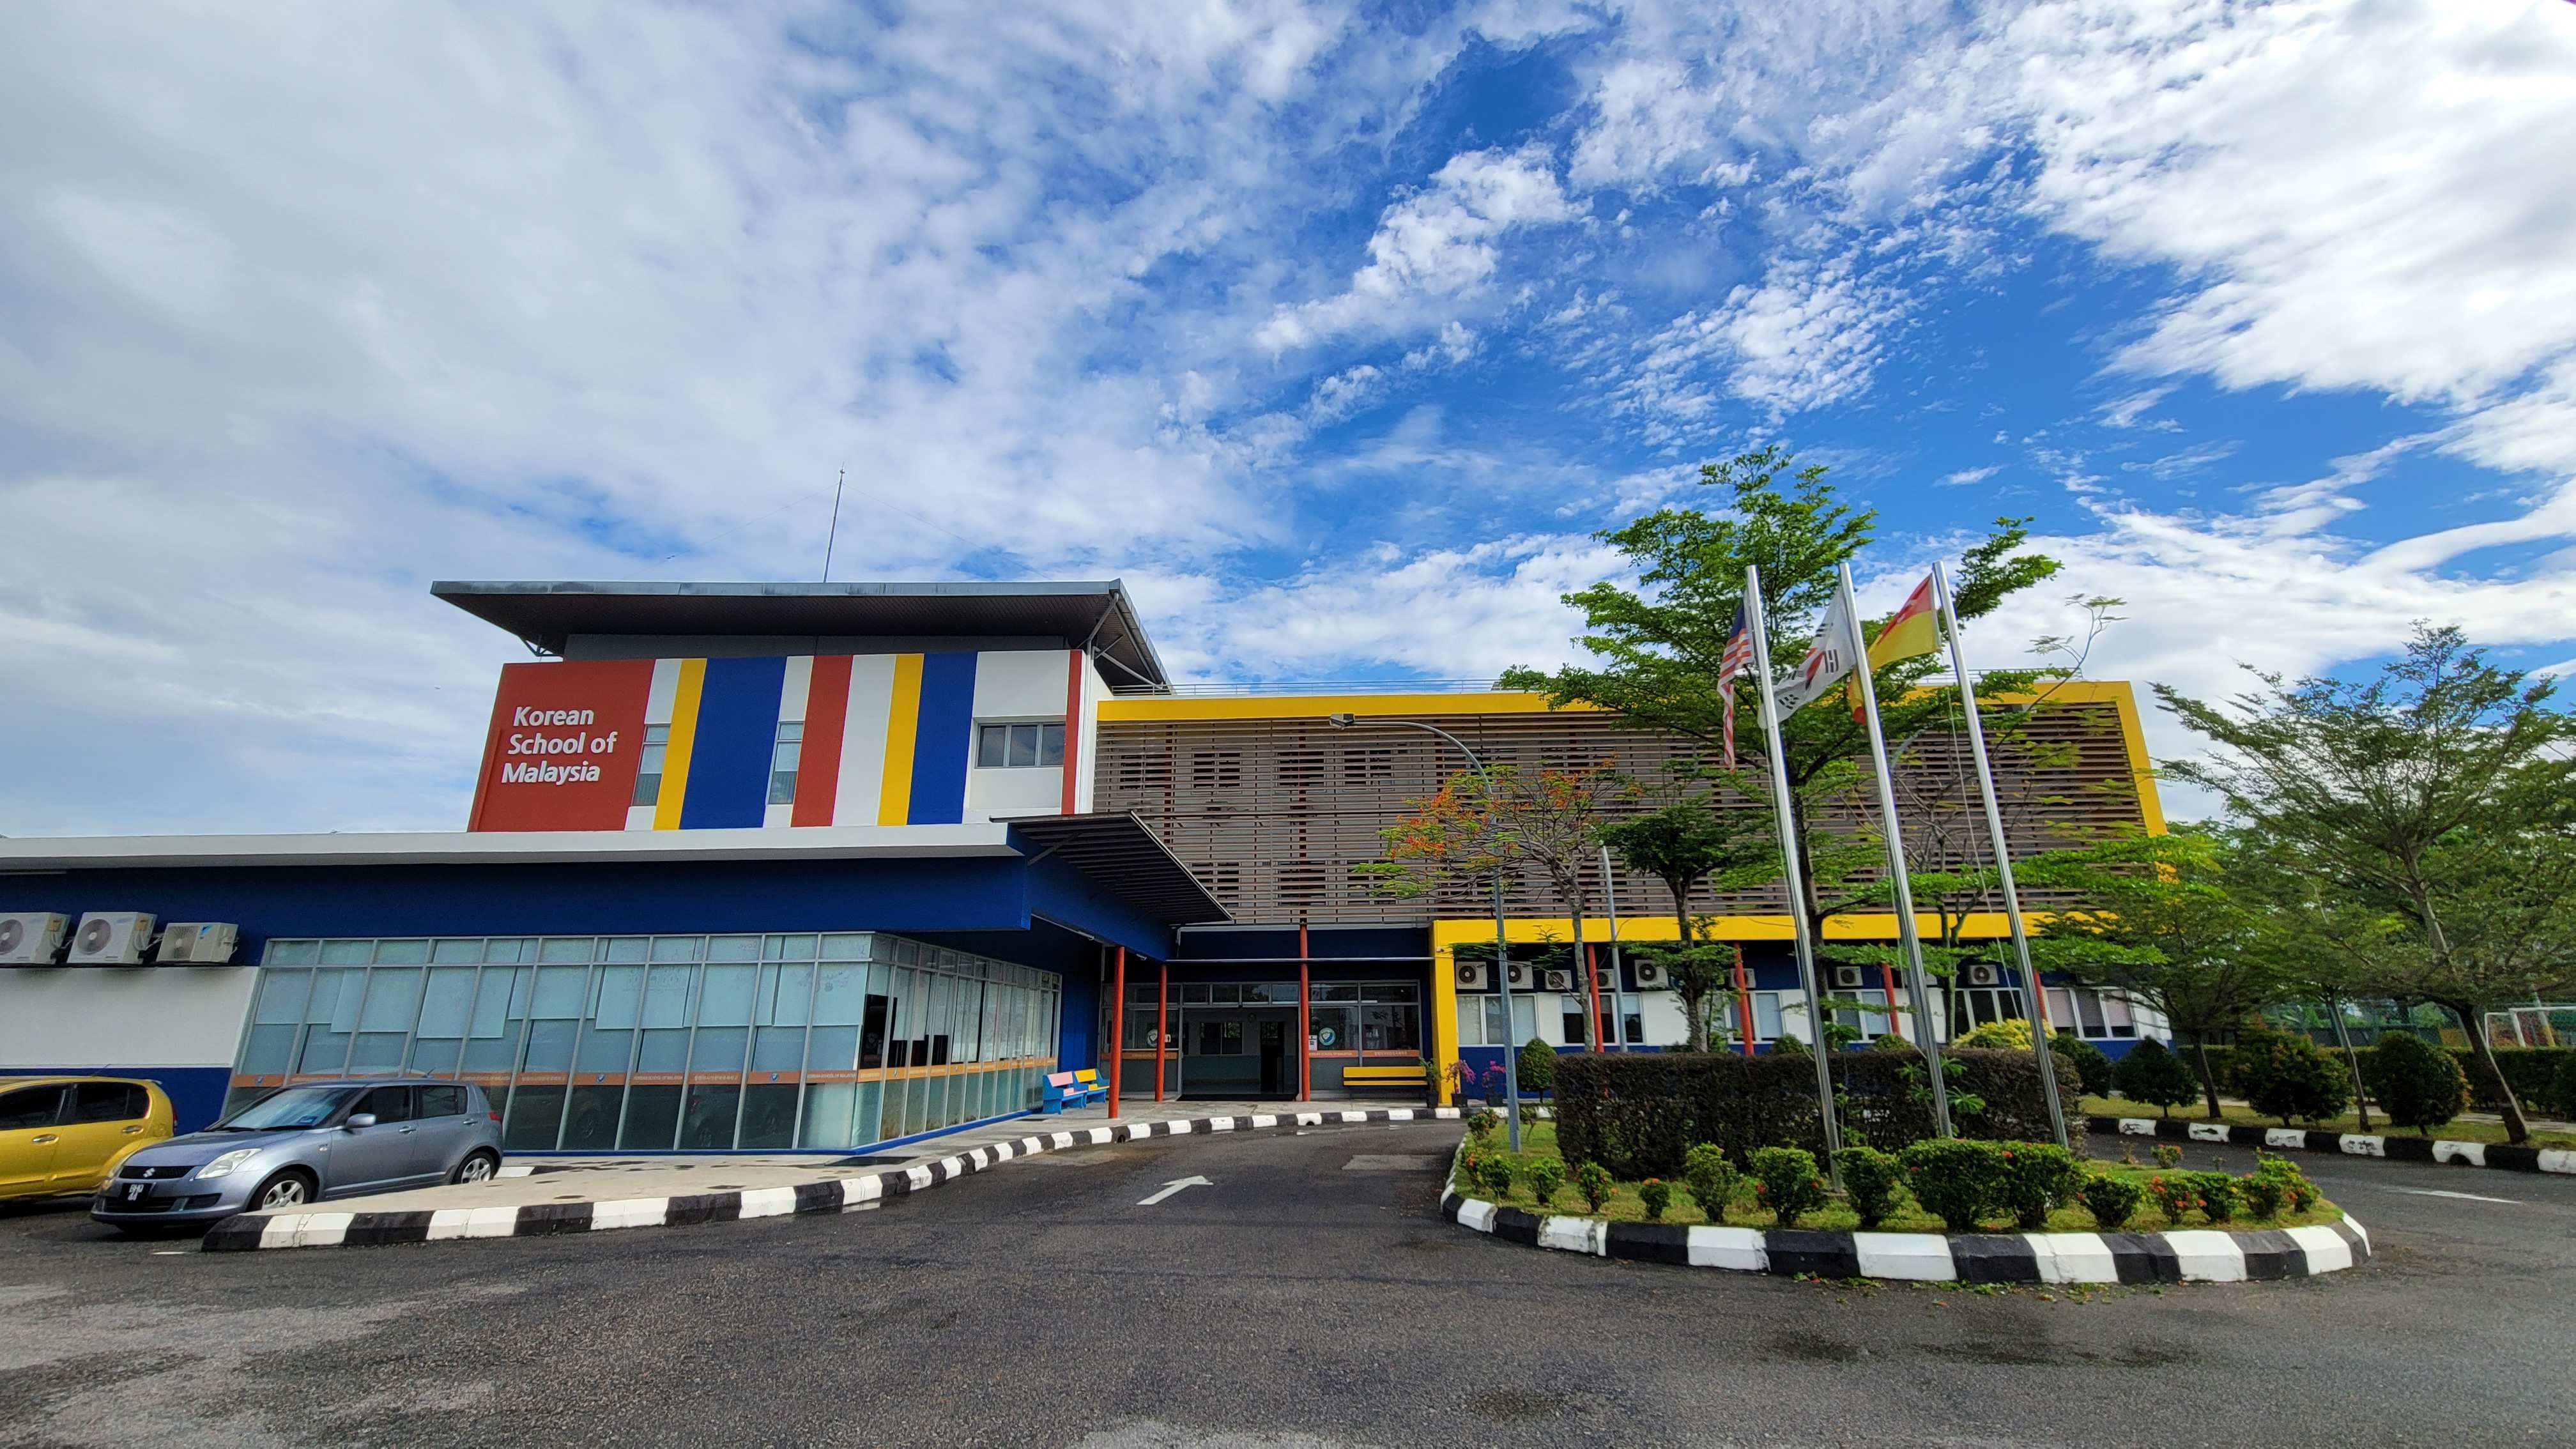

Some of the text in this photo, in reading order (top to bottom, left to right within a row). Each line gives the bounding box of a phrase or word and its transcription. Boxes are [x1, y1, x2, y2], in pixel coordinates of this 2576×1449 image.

[512, 706, 595, 727] Korean
[507, 730, 619, 755] School of
[501, 760, 601, 786] Malaysia
